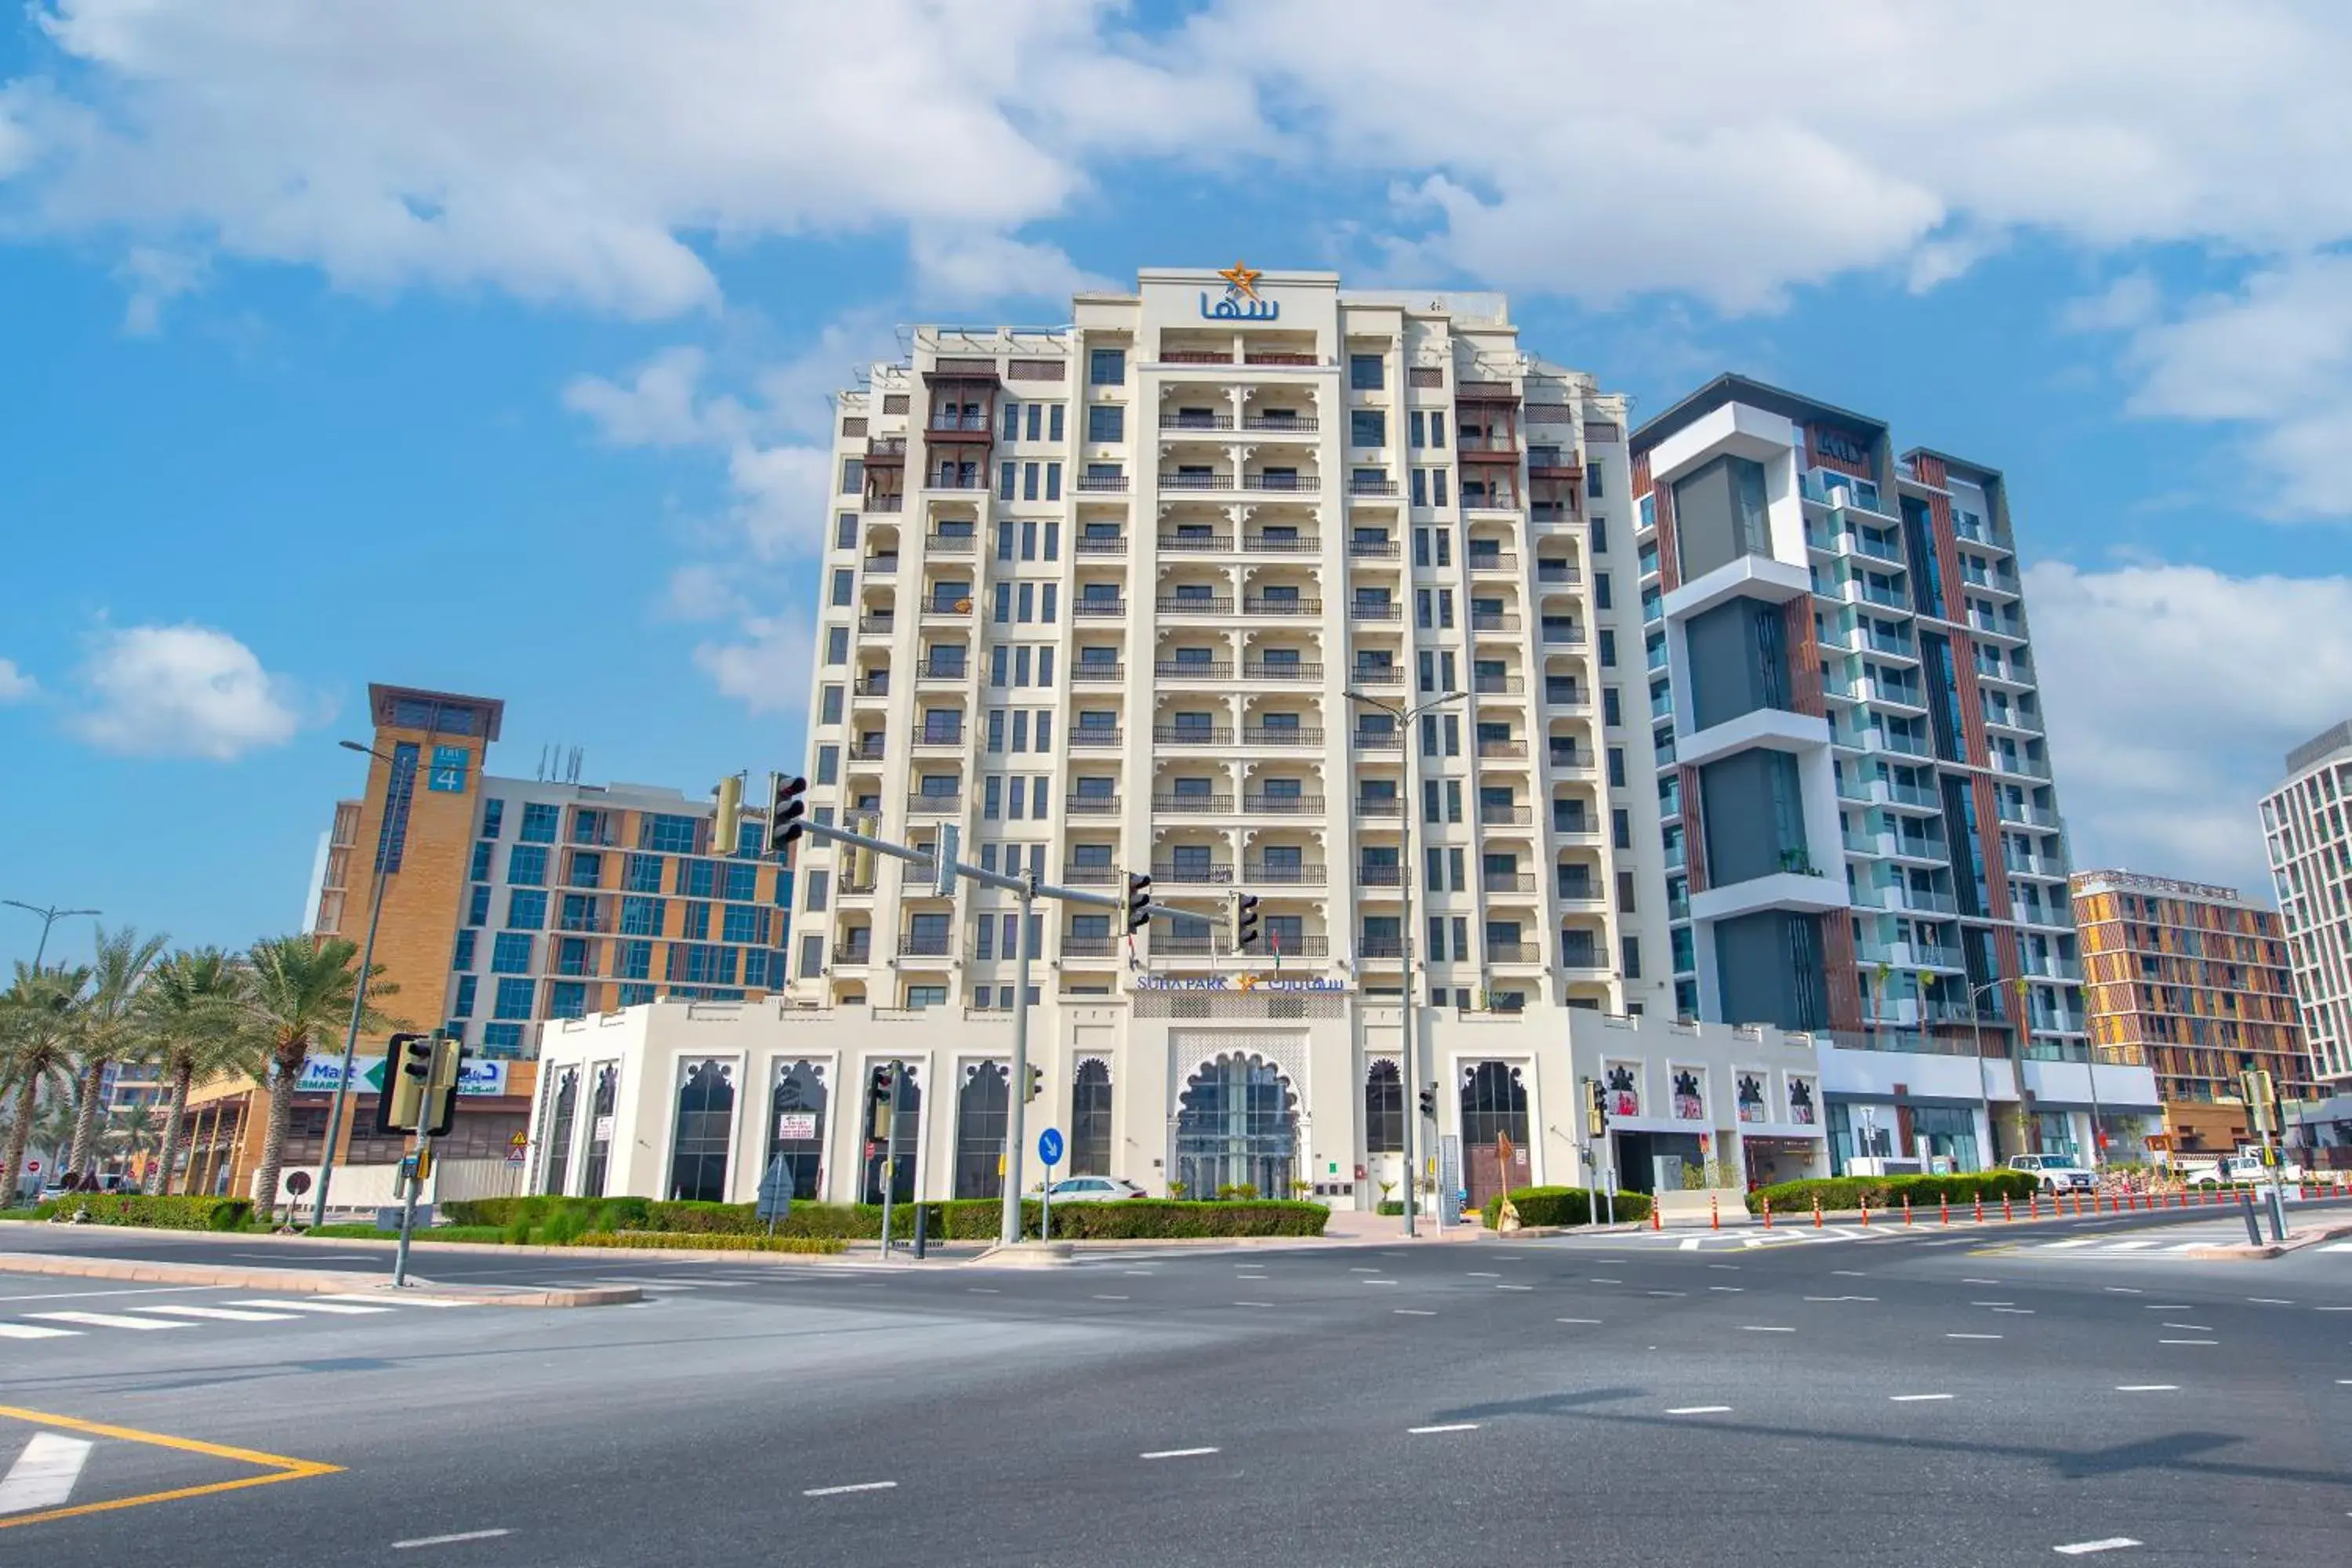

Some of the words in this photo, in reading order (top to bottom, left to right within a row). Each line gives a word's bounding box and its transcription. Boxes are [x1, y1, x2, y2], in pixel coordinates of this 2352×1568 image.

[437, 764, 458, 791] 4
[1185, 978, 1228, 990] PARK
[312, 1064, 357, 1079] Mat
